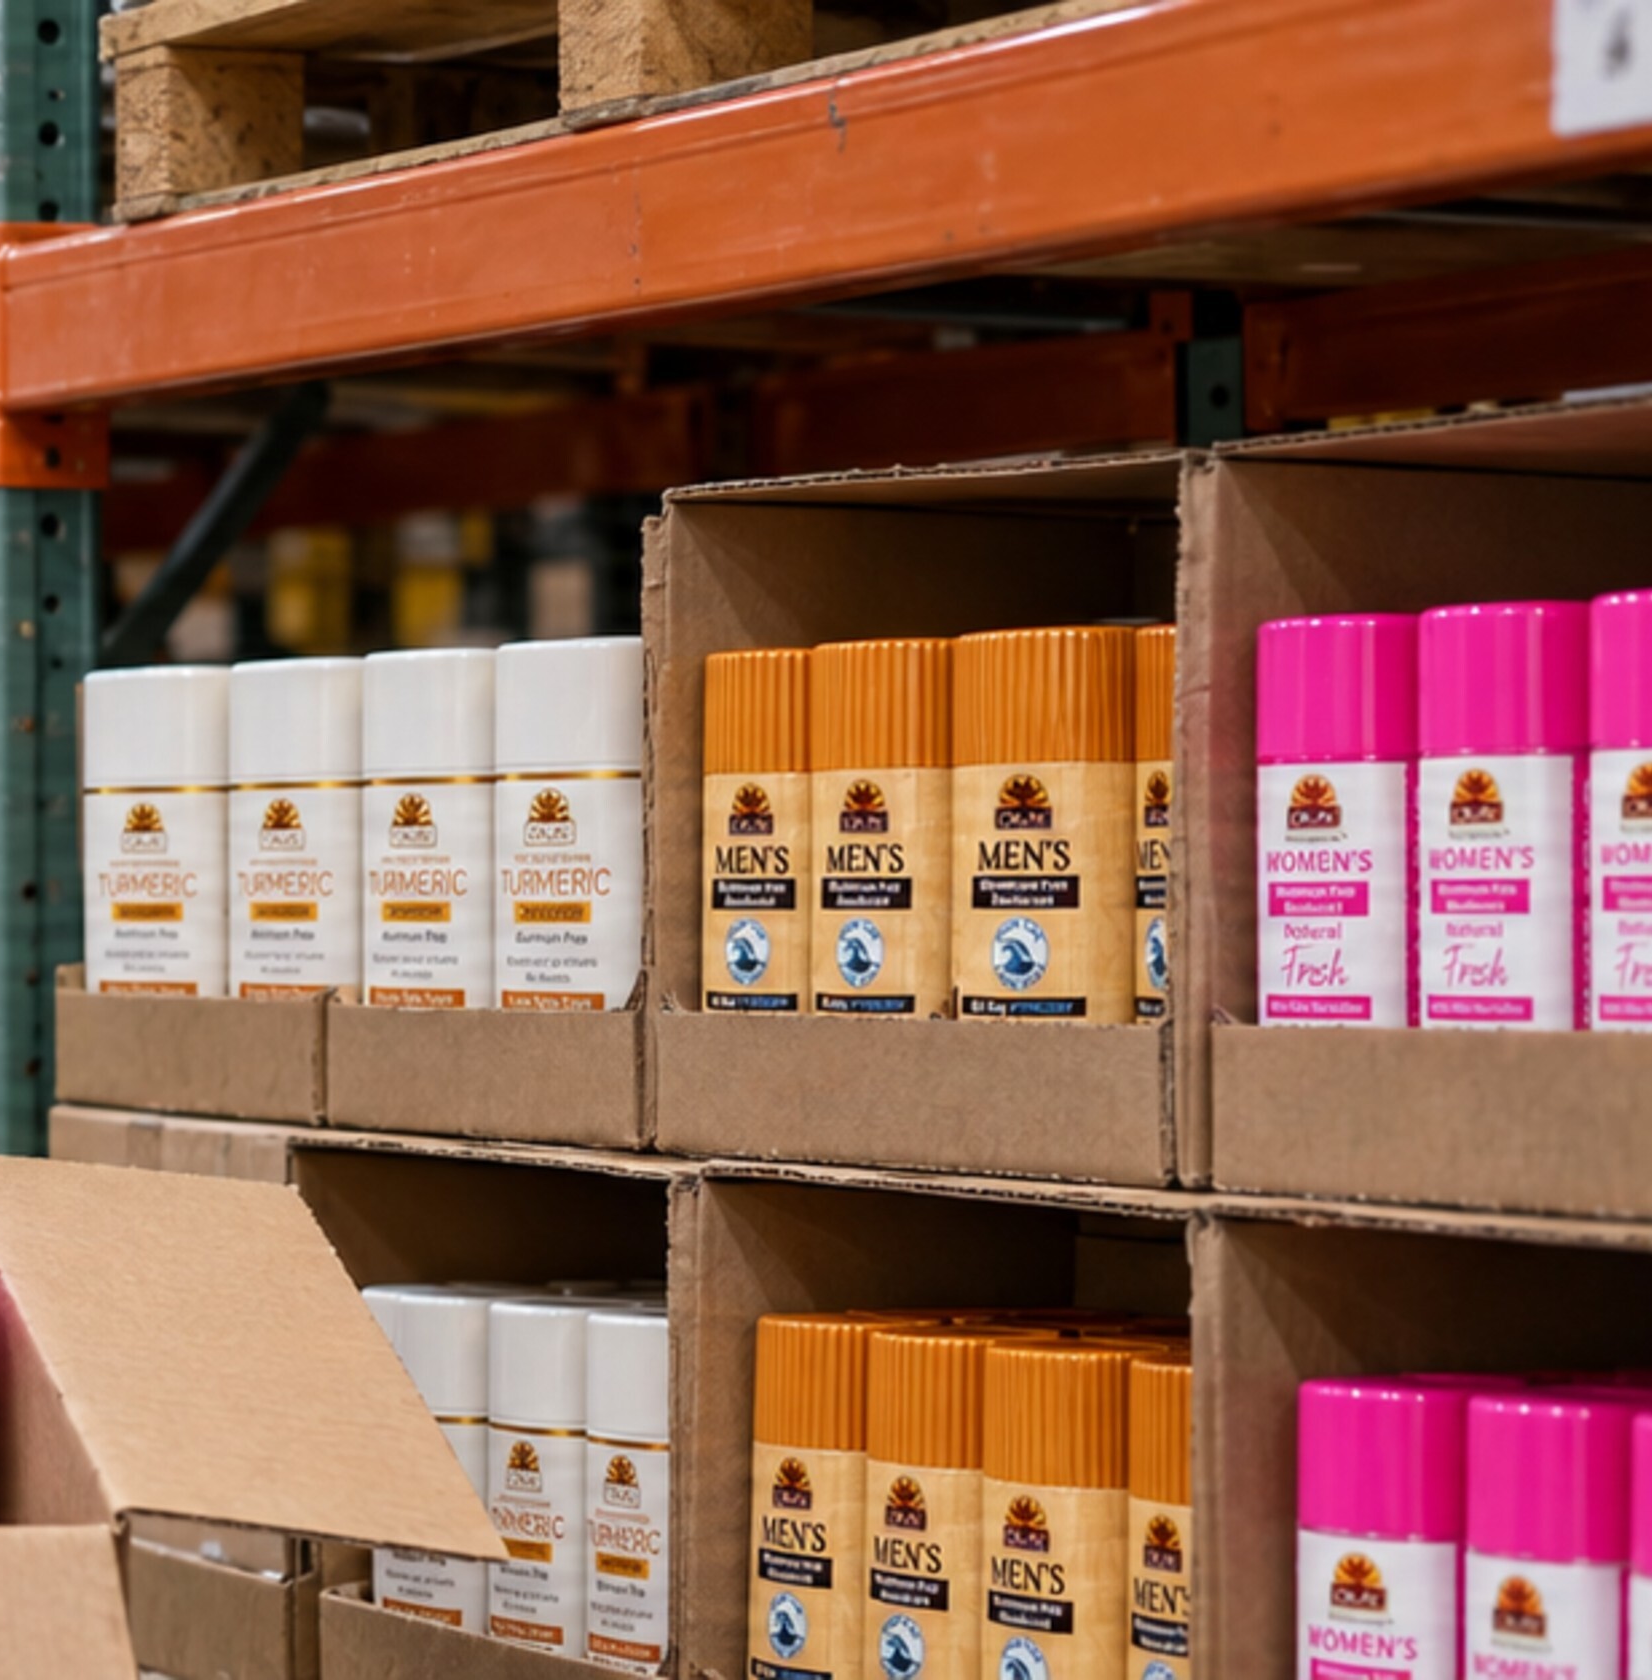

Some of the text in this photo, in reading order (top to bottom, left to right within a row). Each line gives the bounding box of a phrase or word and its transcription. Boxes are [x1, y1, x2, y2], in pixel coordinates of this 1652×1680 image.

[715, 845, 790, 875] MEN'S
[827, 843, 905, 873] MEN'S
[978, 839, 1071, 871] MEN'S
[1266, 850, 1373, 873] WOMEN'S
[1428, 846, 1534, 870] WOMEN'S
[501, 866, 612, 896] TURMERIC
[763, 1515, 827, 1553] MEN'S
[874, 1535, 942, 1574] MEN'S
[991, 1555, 1066, 1595] MEN'S
[1308, 1624, 1418, 1661] WOMEN'S
